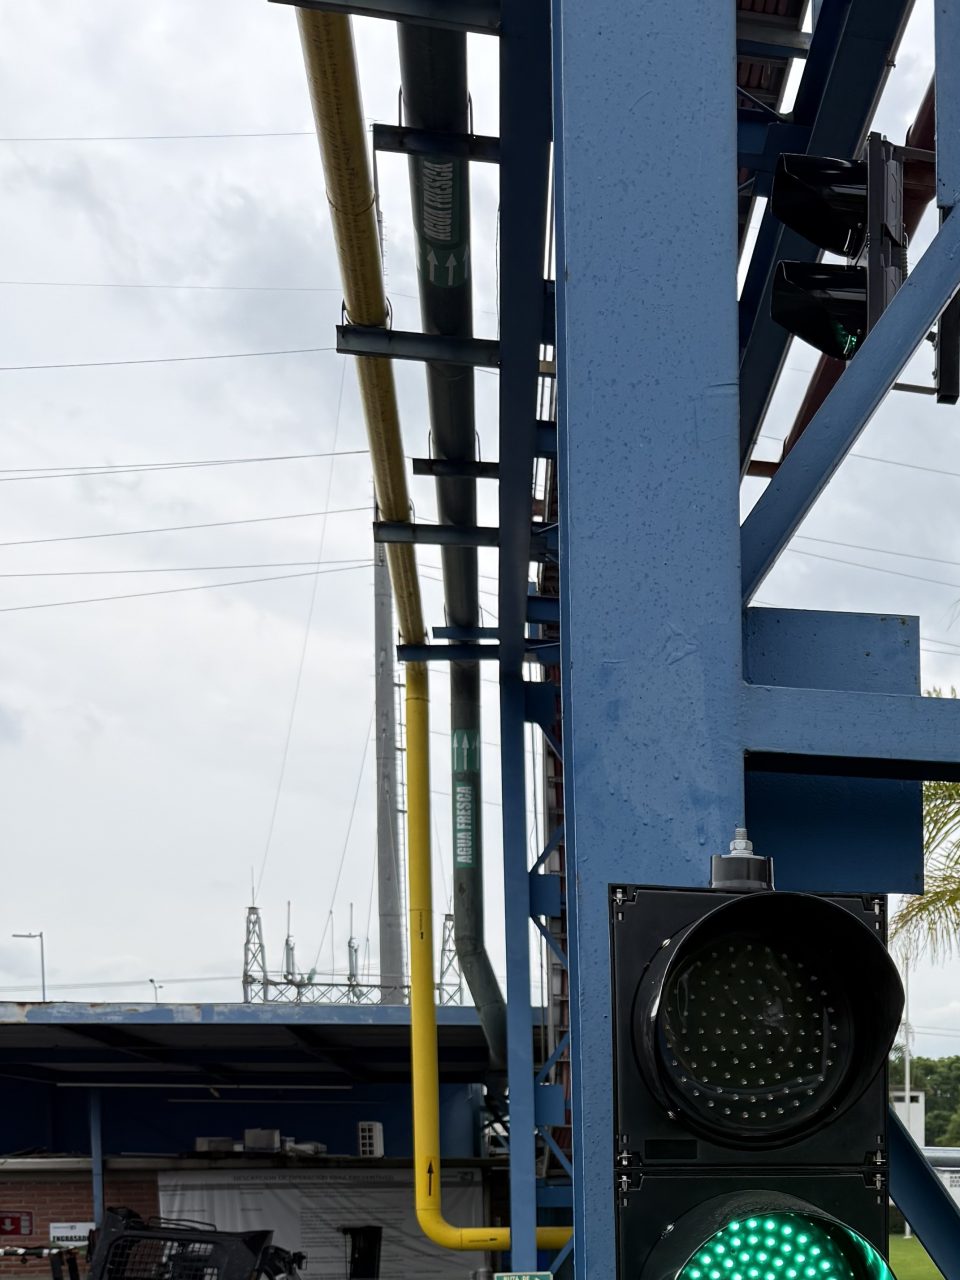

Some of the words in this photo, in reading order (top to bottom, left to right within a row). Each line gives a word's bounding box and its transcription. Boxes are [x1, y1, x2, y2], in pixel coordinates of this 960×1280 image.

[423, 161, 453, 208] FRESCA
[423, 205, 452, 240] AGUA
[456, 786, 472, 830] FRESCA
[456, 831, 472, 864] AGUA
